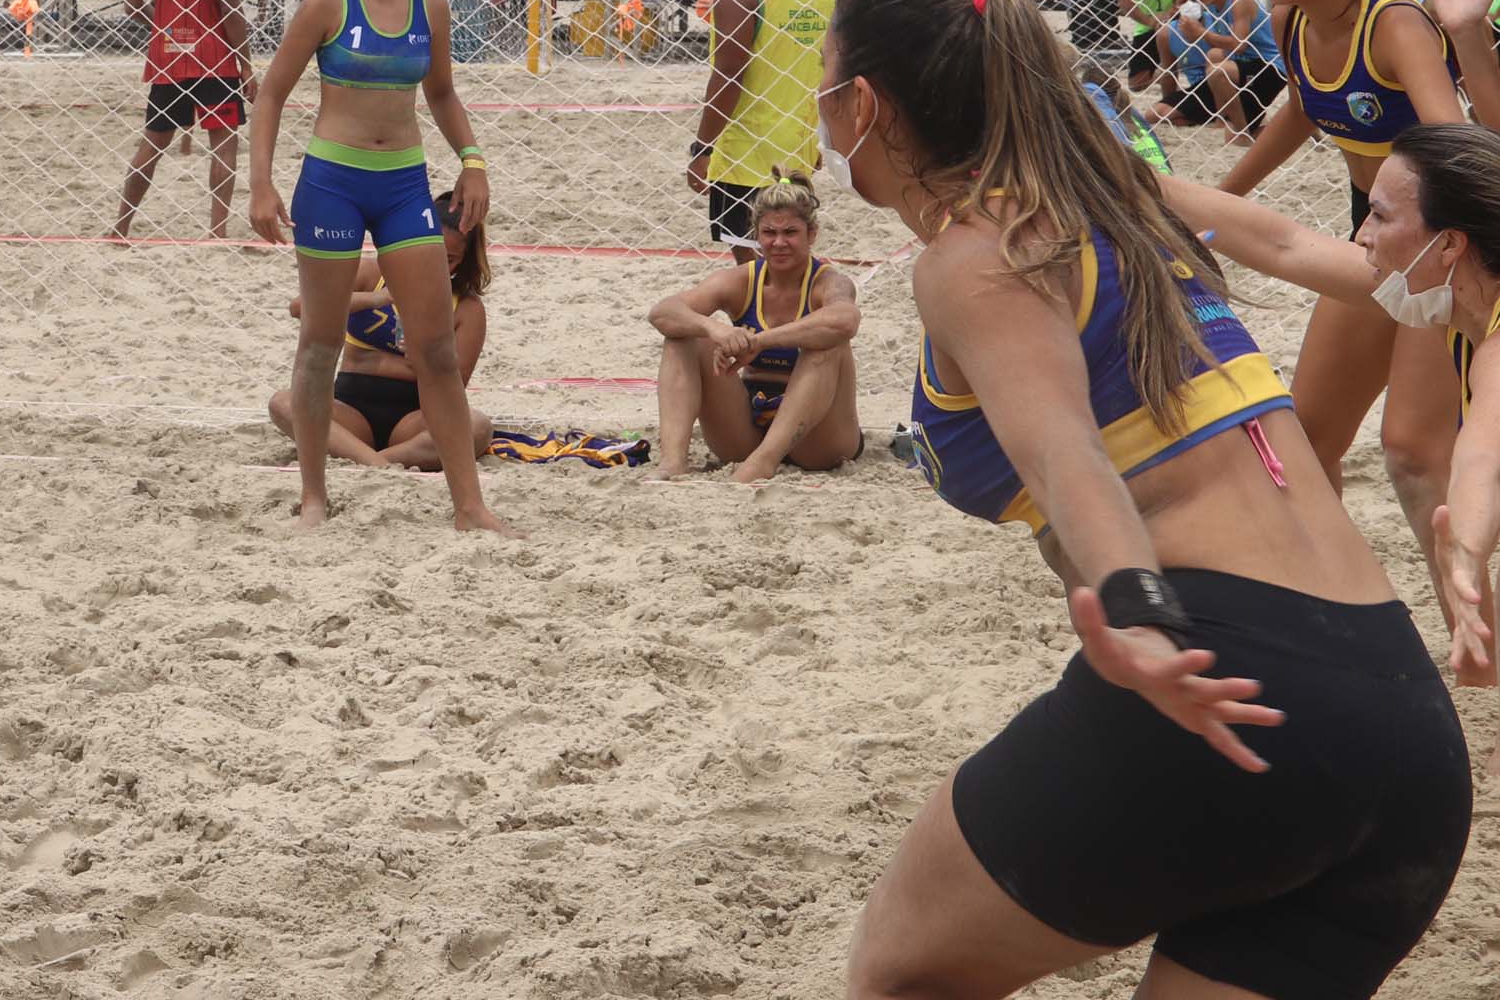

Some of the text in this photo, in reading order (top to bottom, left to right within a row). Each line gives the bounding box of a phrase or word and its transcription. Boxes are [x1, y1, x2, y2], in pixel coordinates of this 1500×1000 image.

[350, 26, 363, 49] 1
[421, 208, 435, 229] 1
[326, 229, 356, 240] IDEC
